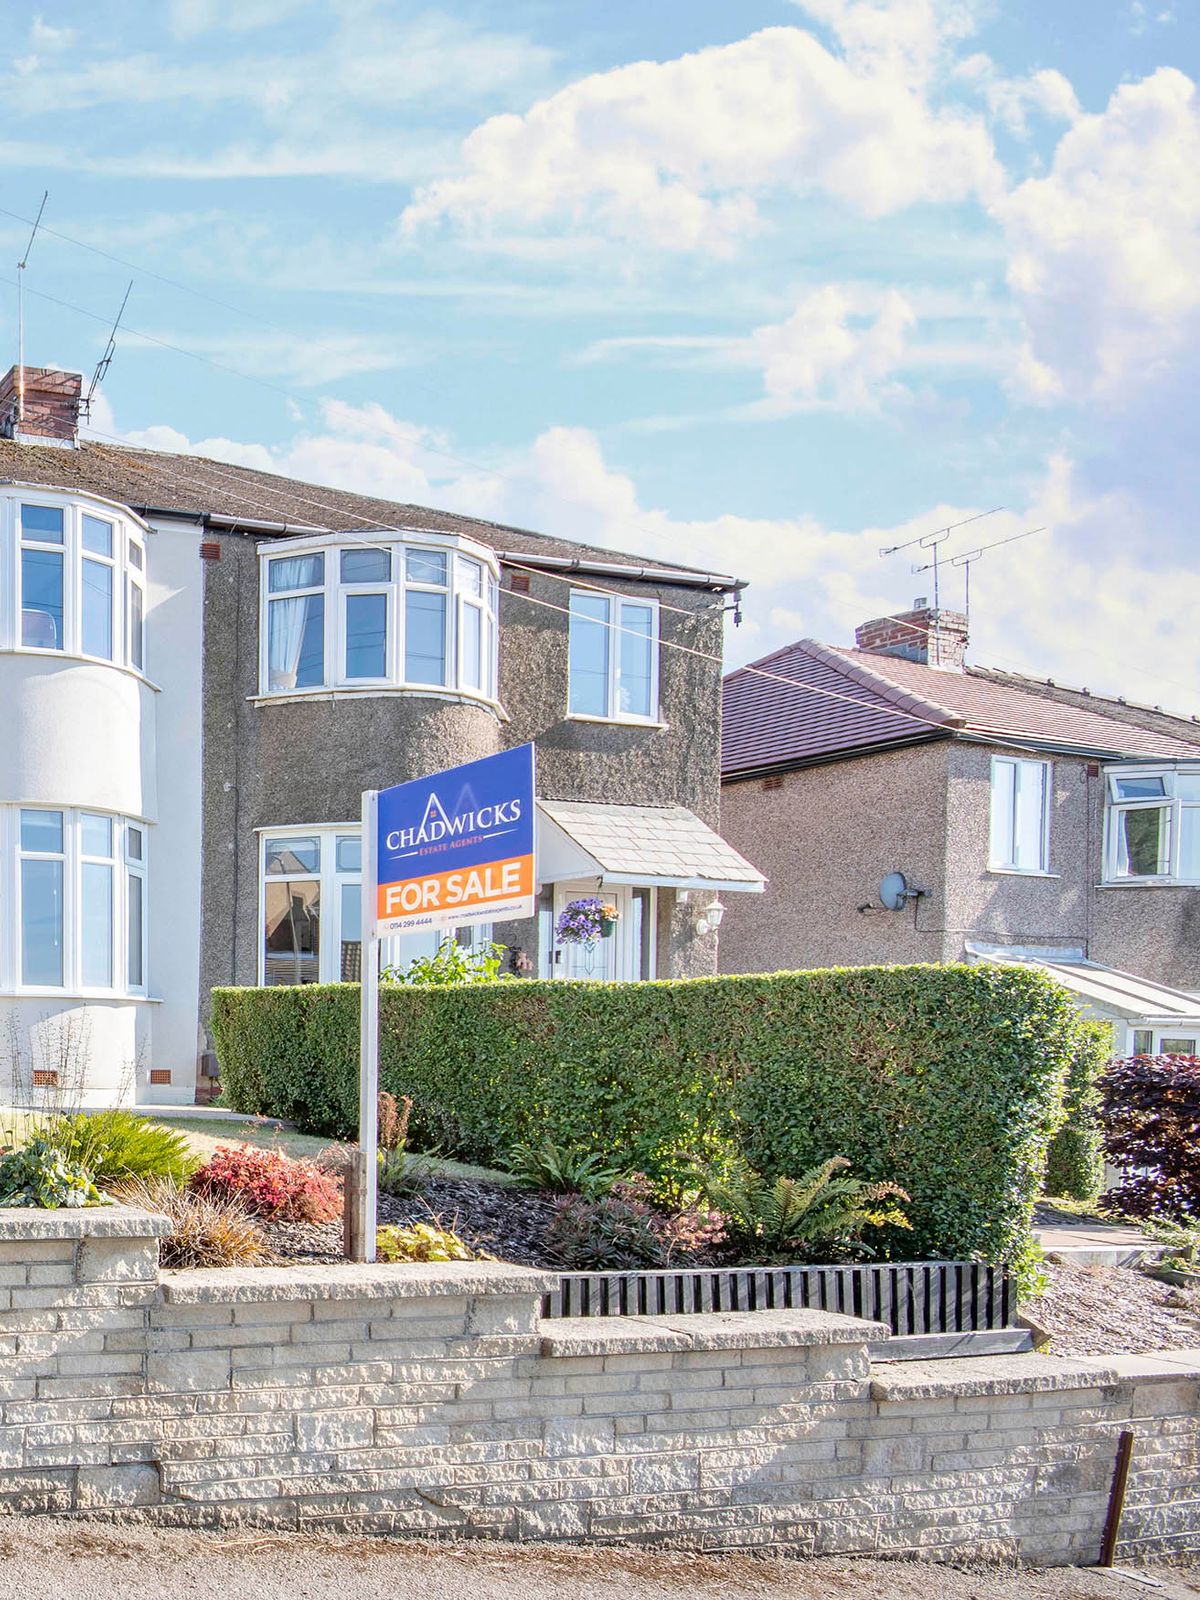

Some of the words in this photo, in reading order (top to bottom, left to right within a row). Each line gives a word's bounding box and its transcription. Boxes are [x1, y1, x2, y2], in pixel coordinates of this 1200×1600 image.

[386, 793, 521, 850] CHADWICKS
[419, 843, 448, 856] ESTATE
[450, 835, 484, 849] AGENTS
[385, 879, 441, 914] FOR
[446, 862, 521, 904] SALE
